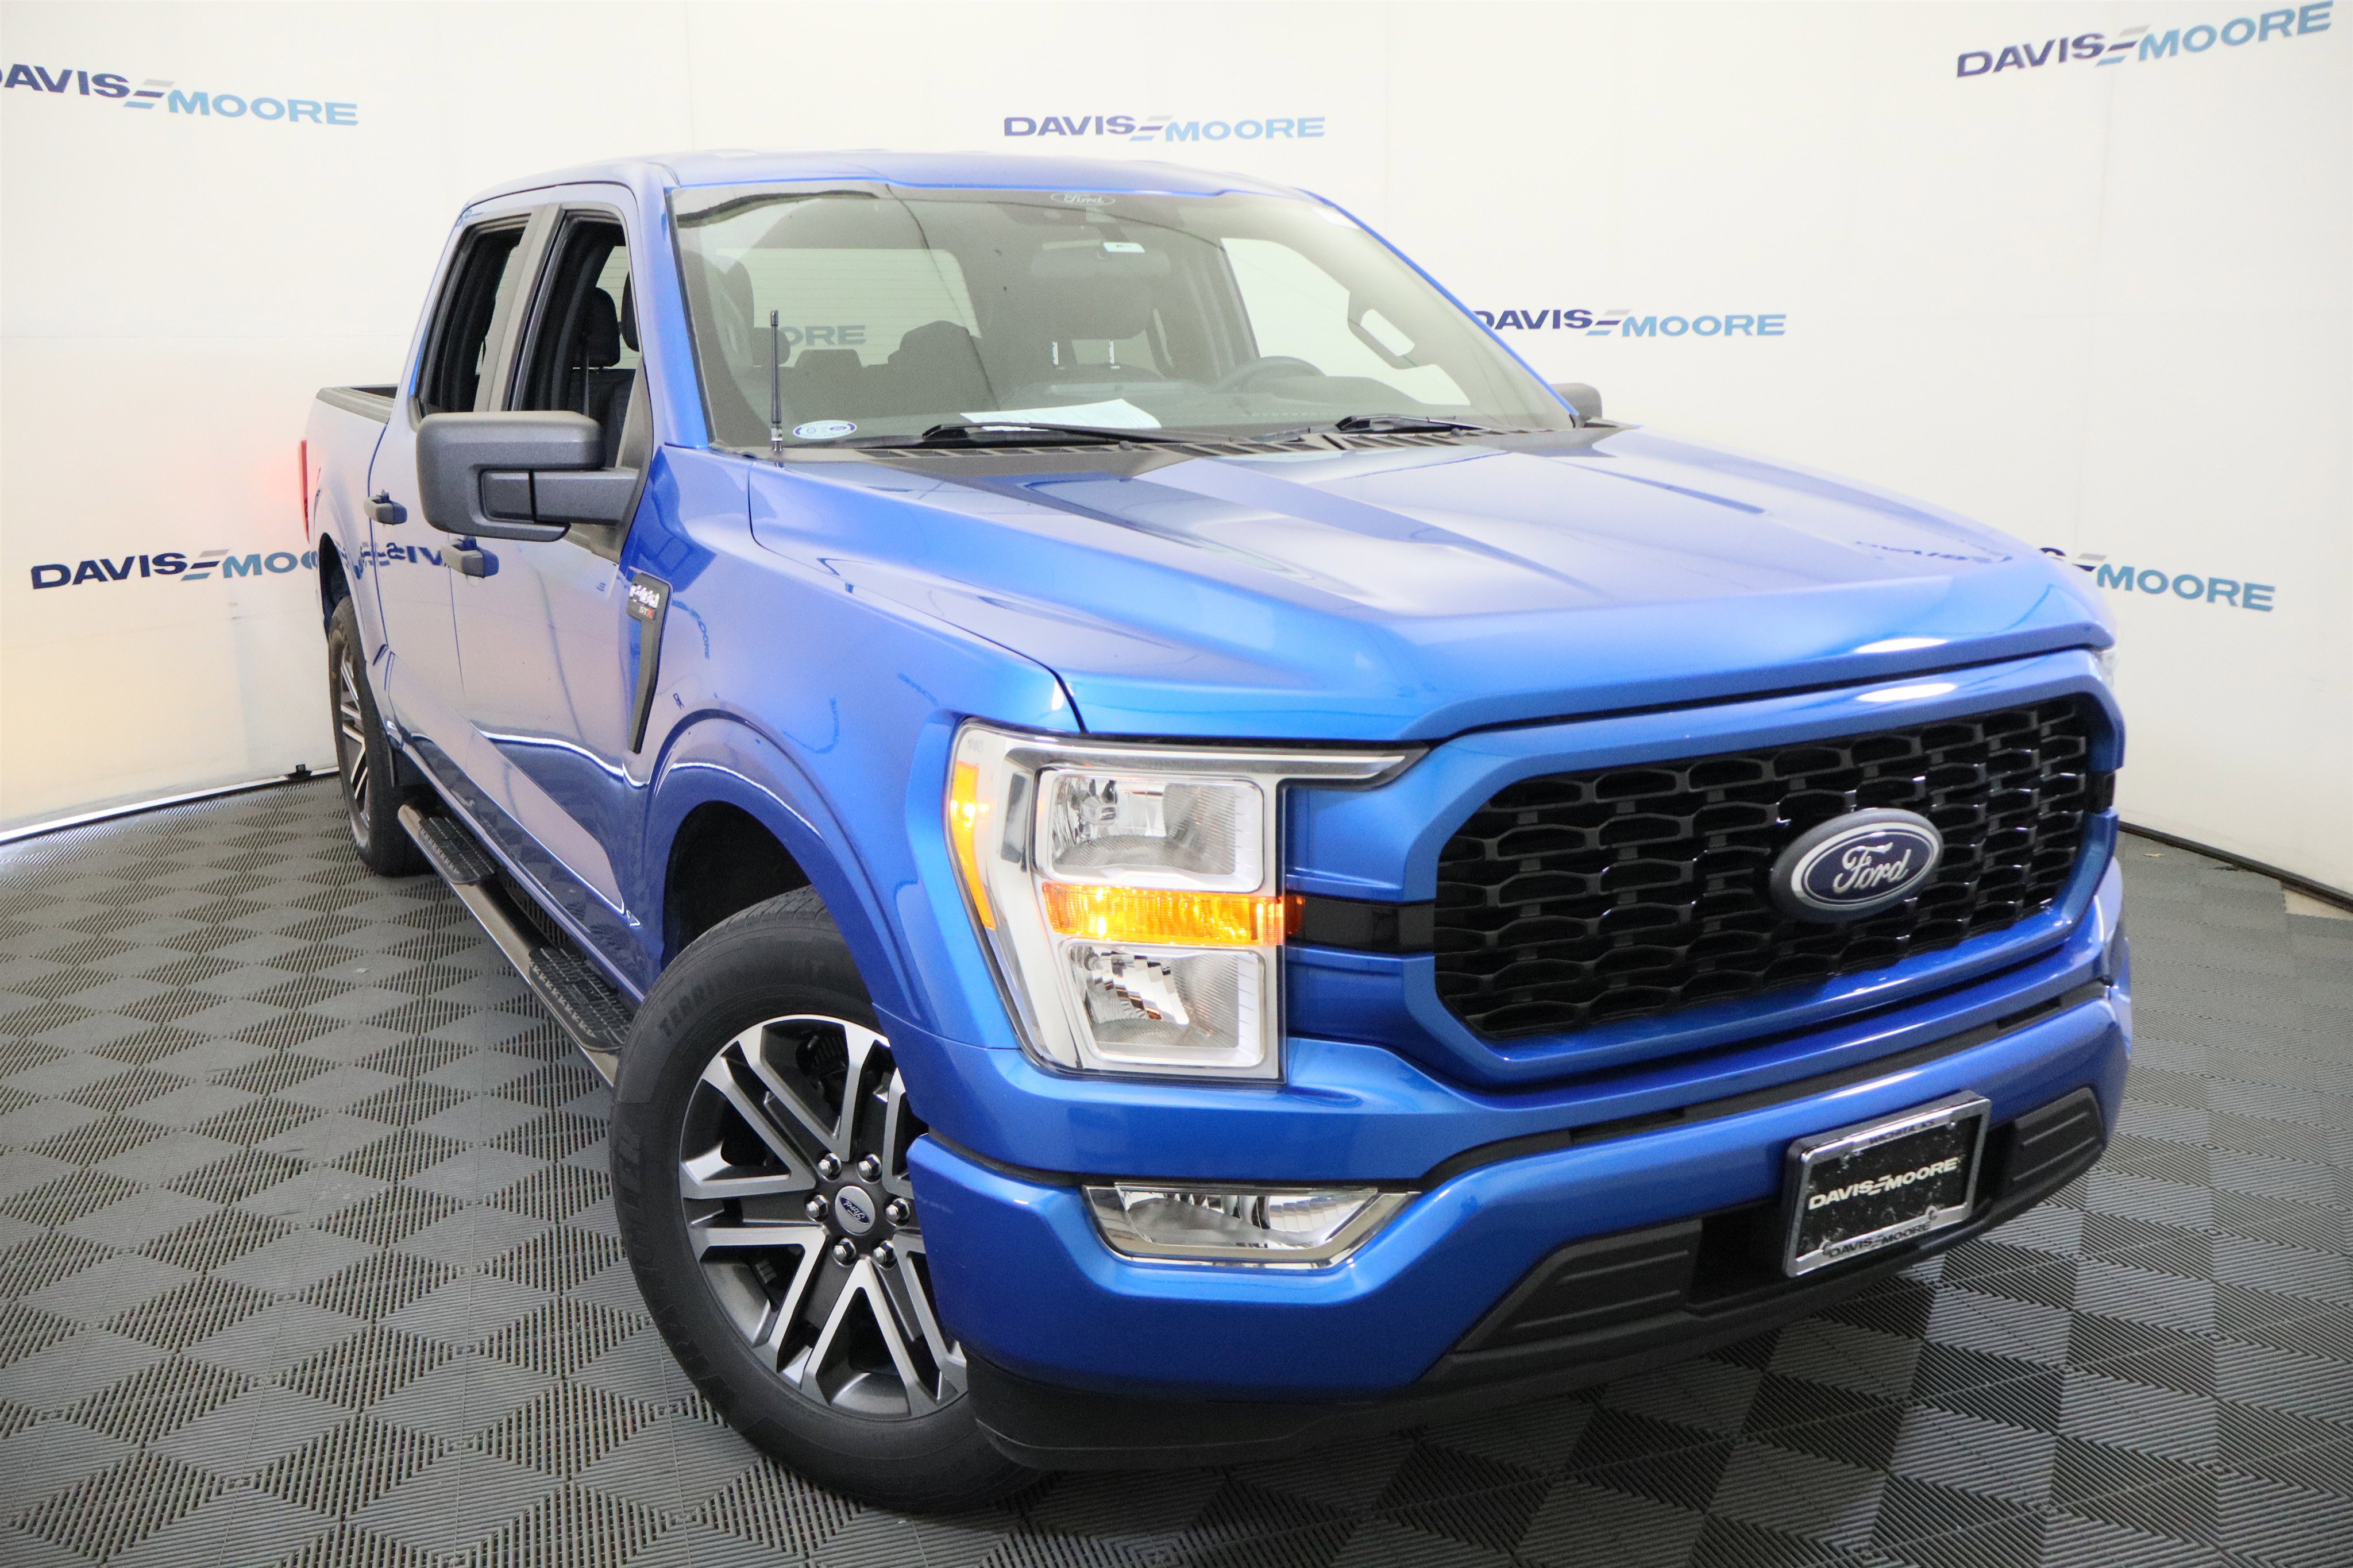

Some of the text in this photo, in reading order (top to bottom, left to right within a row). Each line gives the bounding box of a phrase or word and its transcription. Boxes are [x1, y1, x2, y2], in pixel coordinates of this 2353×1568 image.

[1957, 0, 2334, 78] DAVIS MOORE
[0, 63, 359, 126] AVIS MOORE
[1004, 115, 1326, 142] DAVIS MOORE
[1622, 314, 1787, 337] MOORE
[32, 552, 188, 590] DAVIS
[2097, 563, 2276, 612] MOORE
[639, 606, 654, 619] STX
[1833, 842, 1912, 894] Ford
[1808, 1157, 1959, 1210] DAVIS MOORE
[843, 1200, 865, 1221] Ford
[1829, 1221, 1931, 1257] DAVIS MOORE
